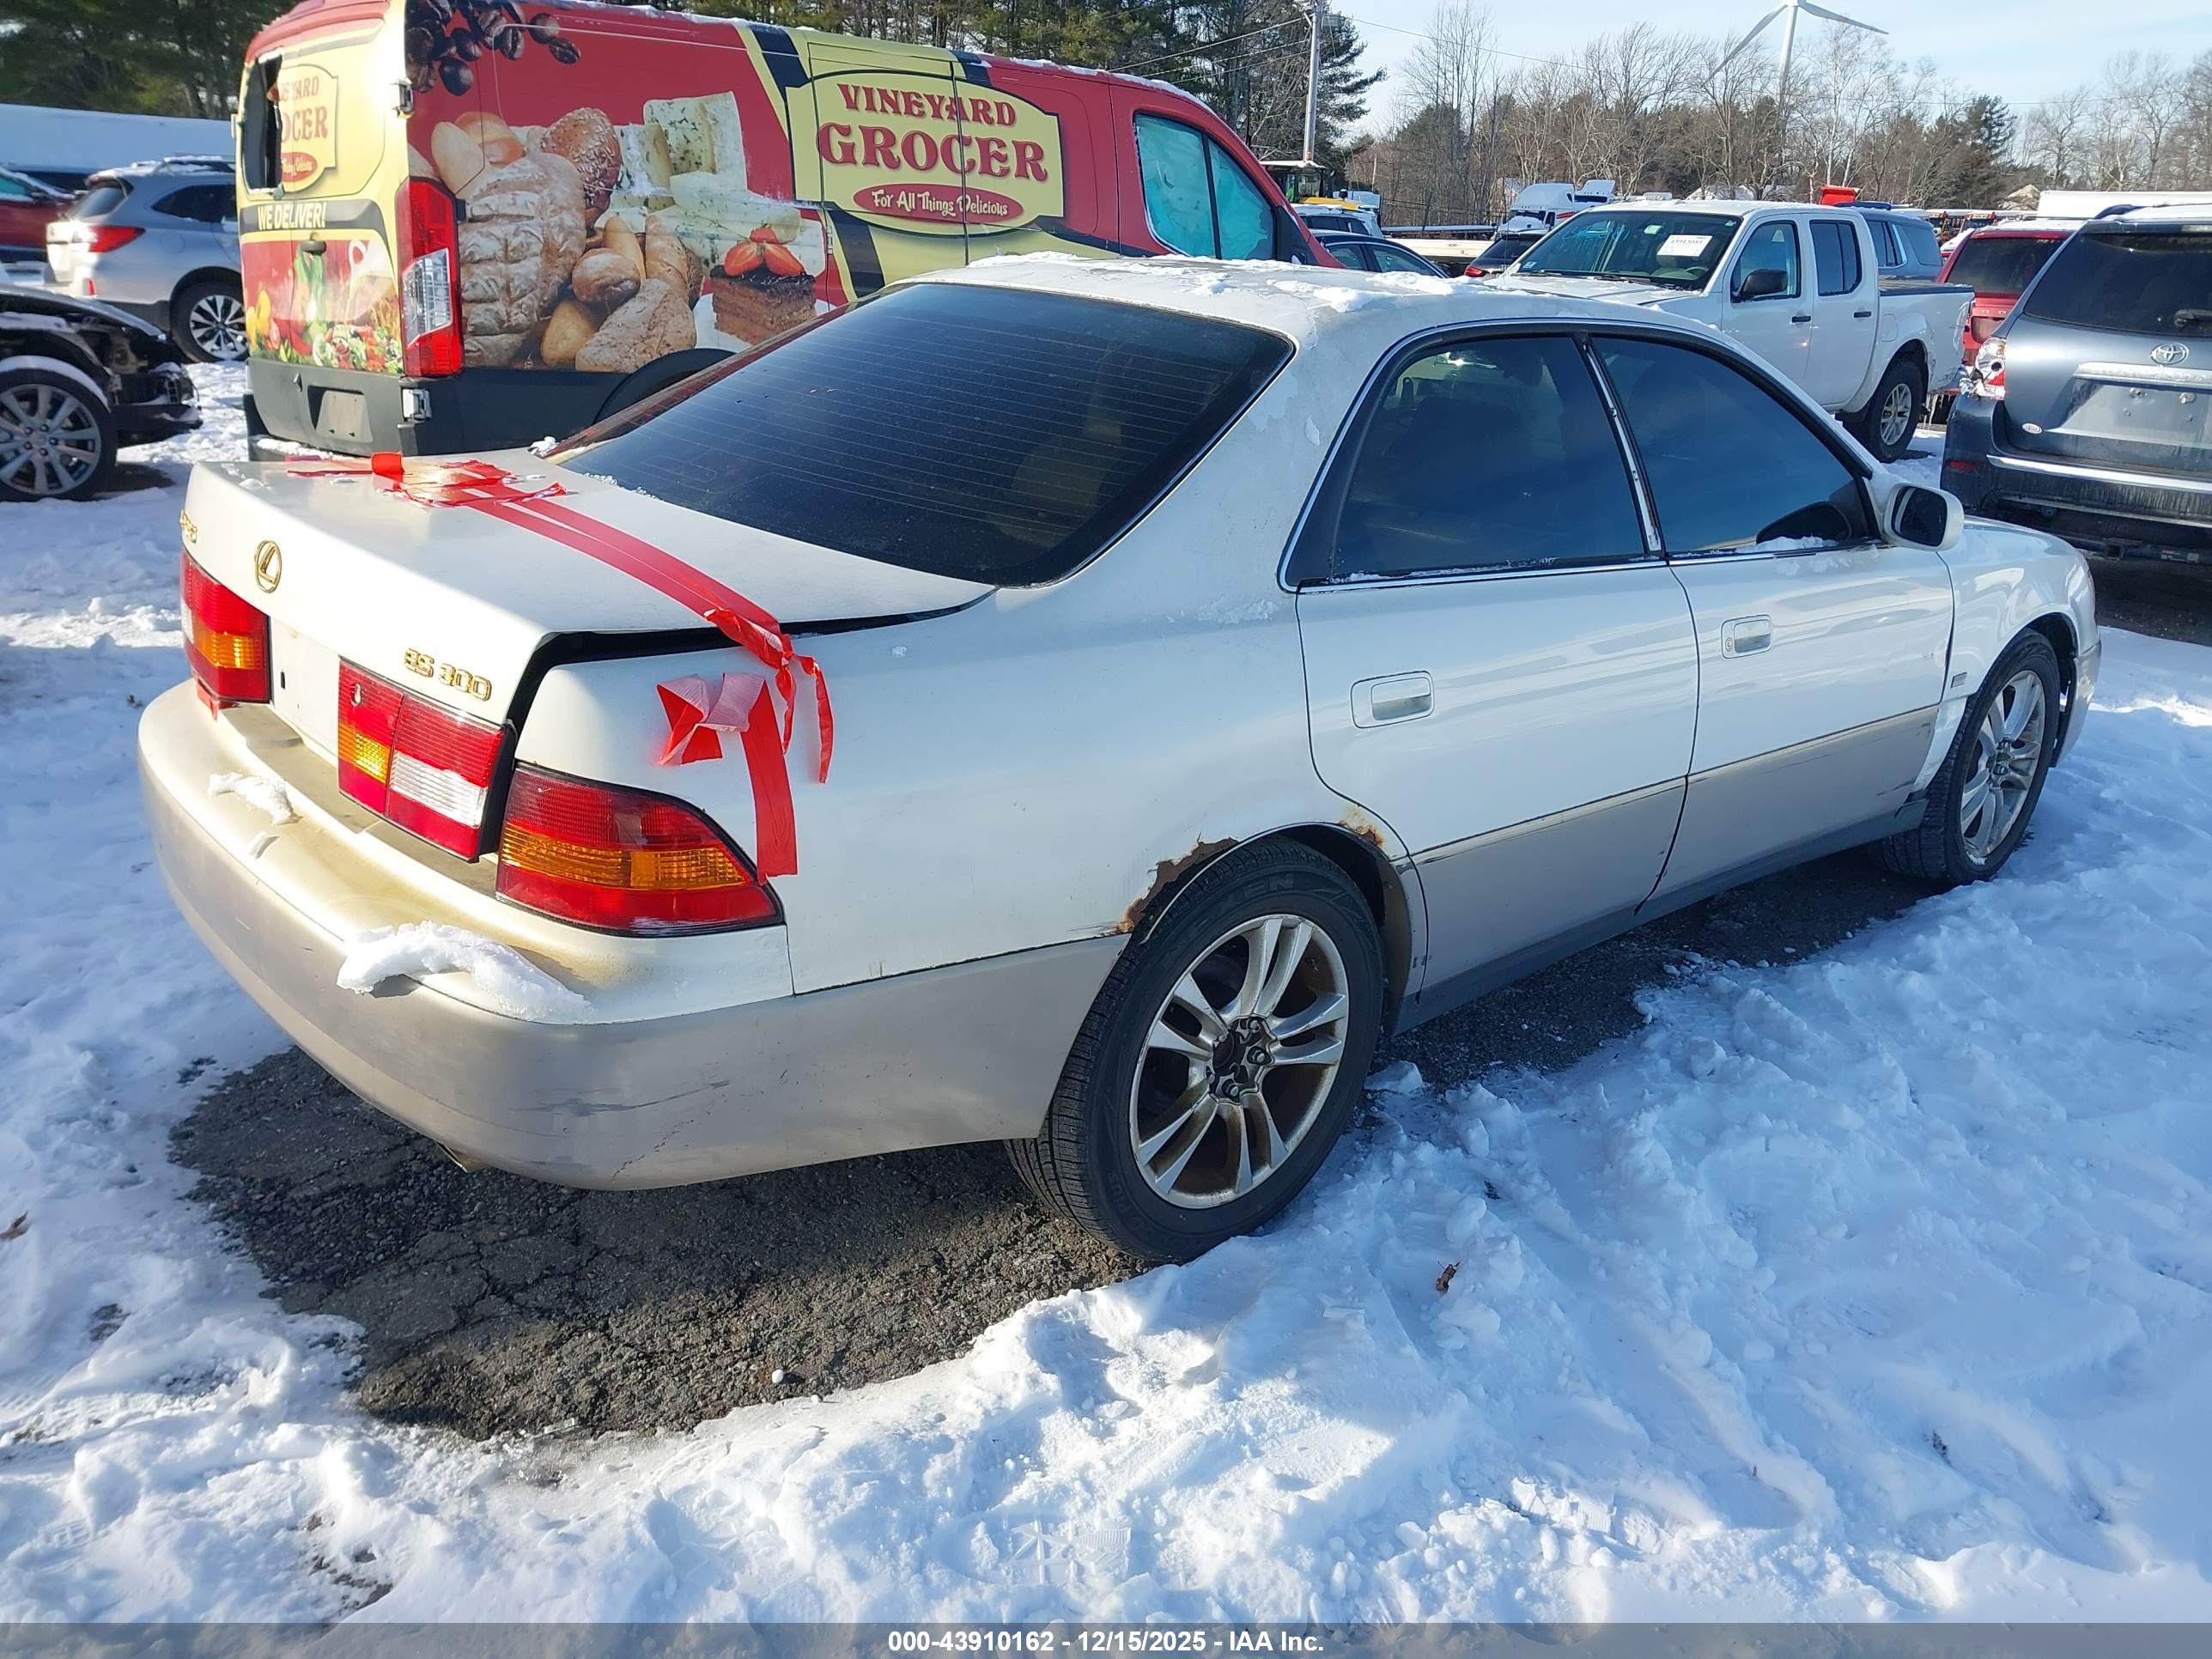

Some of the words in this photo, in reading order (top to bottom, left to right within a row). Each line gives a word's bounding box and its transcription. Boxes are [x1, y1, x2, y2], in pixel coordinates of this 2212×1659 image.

[837, 82, 1017, 126] VINEYARD
[282, 106, 329, 143] OCER
[817, 122, 1048, 182] GROCER
[258, 205, 273, 230] WE
[274, 202, 326, 229] DELIVER!
[872, 189, 894, 208] For
[896, 191, 915, 212] All
[917, 191, 957, 216] Things
[957, 194, 1008, 216] Delicious
[404, 647, 434, 678] ES
[439, 663, 492, 702] 300
